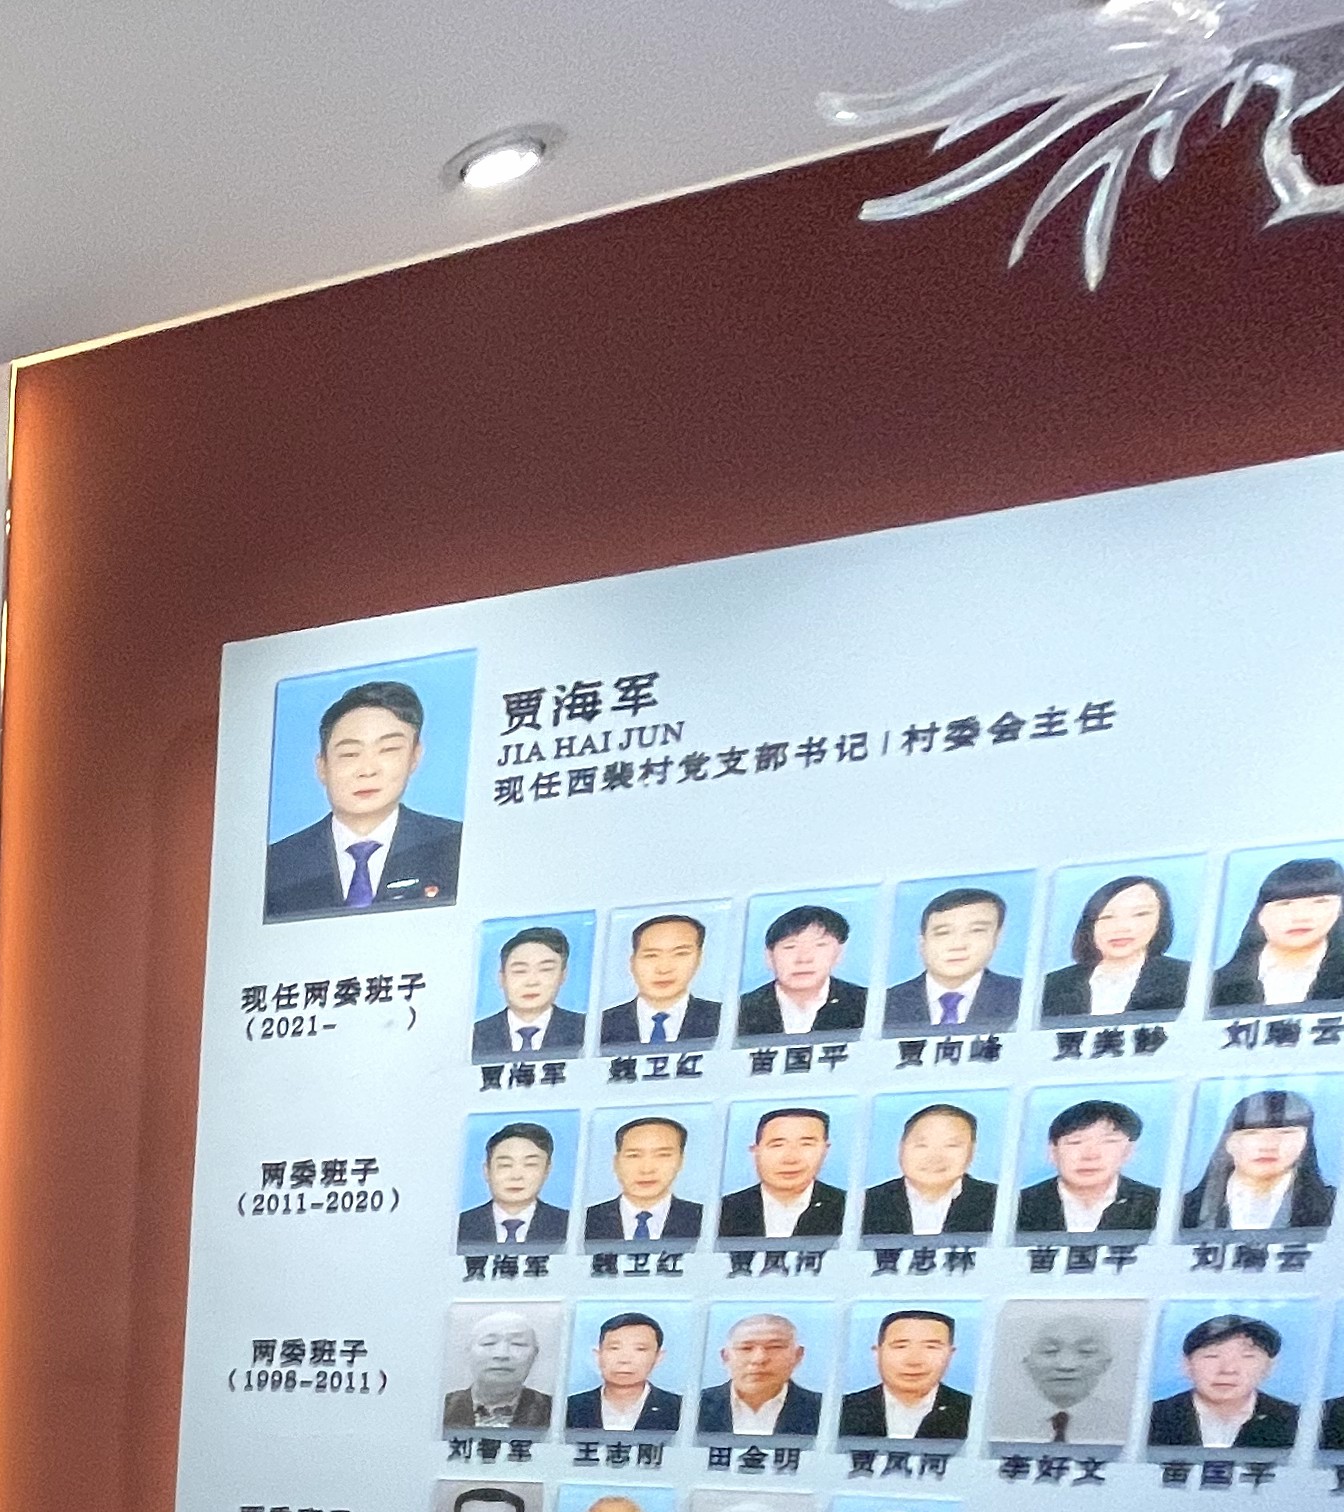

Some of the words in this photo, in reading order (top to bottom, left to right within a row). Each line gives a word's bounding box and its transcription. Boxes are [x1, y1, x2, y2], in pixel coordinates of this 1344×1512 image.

[500, 671, 660, 737] 贾海军
[497, 740, 546, 766] JIA
[553, 730, 612, 760] HAI
[618, 720, 686, 751] JUN
[241, 973, 426, 1013] 现任两委班子
[750, 1043, 850, 1076] 苗国平
[480, 1062, 567, 1092] 贾海军
[261, 1158, 379, 1190] 两委班子
[462, 1254, 550, 1282] 贾海军
[1028, 1244, 1137, 1274] 苗国平
[252, 1338, 368, 1366] 两委班子
[574, 1441, 664, 1468] 王志刚
[708, 1446, 800, 1473] 田金明
